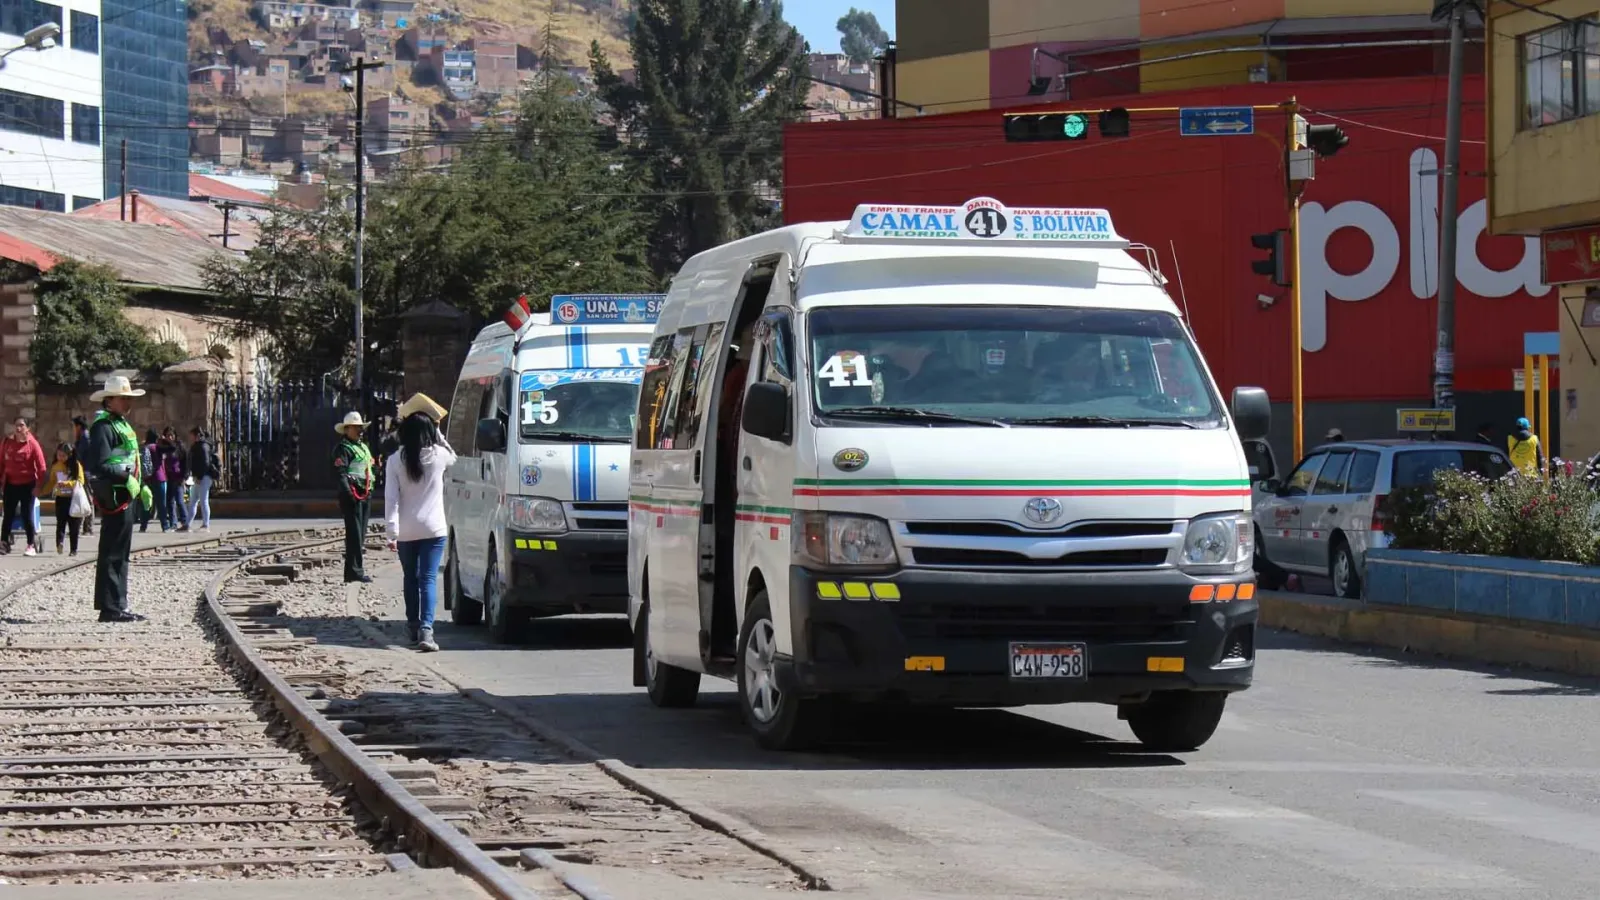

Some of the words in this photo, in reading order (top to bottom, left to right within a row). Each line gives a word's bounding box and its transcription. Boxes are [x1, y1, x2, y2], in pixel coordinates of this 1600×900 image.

[966, 201, 1002, 212] DANTE
[861, 213, 959, 231] CAMAL
[969, 211, 1001, 236] 41
[1013, 215, 1028, 232] S.
[1033, 215, 1108, 232] BOLIVAR
[884, 230, 958, 238] FLORIDA
[560, 305, 575, 318] 15
[587, 301, 618, 313] UNA
[818, 354, 873, 387] 41
[521, 400, 559, 425] 15
[844, 452, 858, 460] 07
